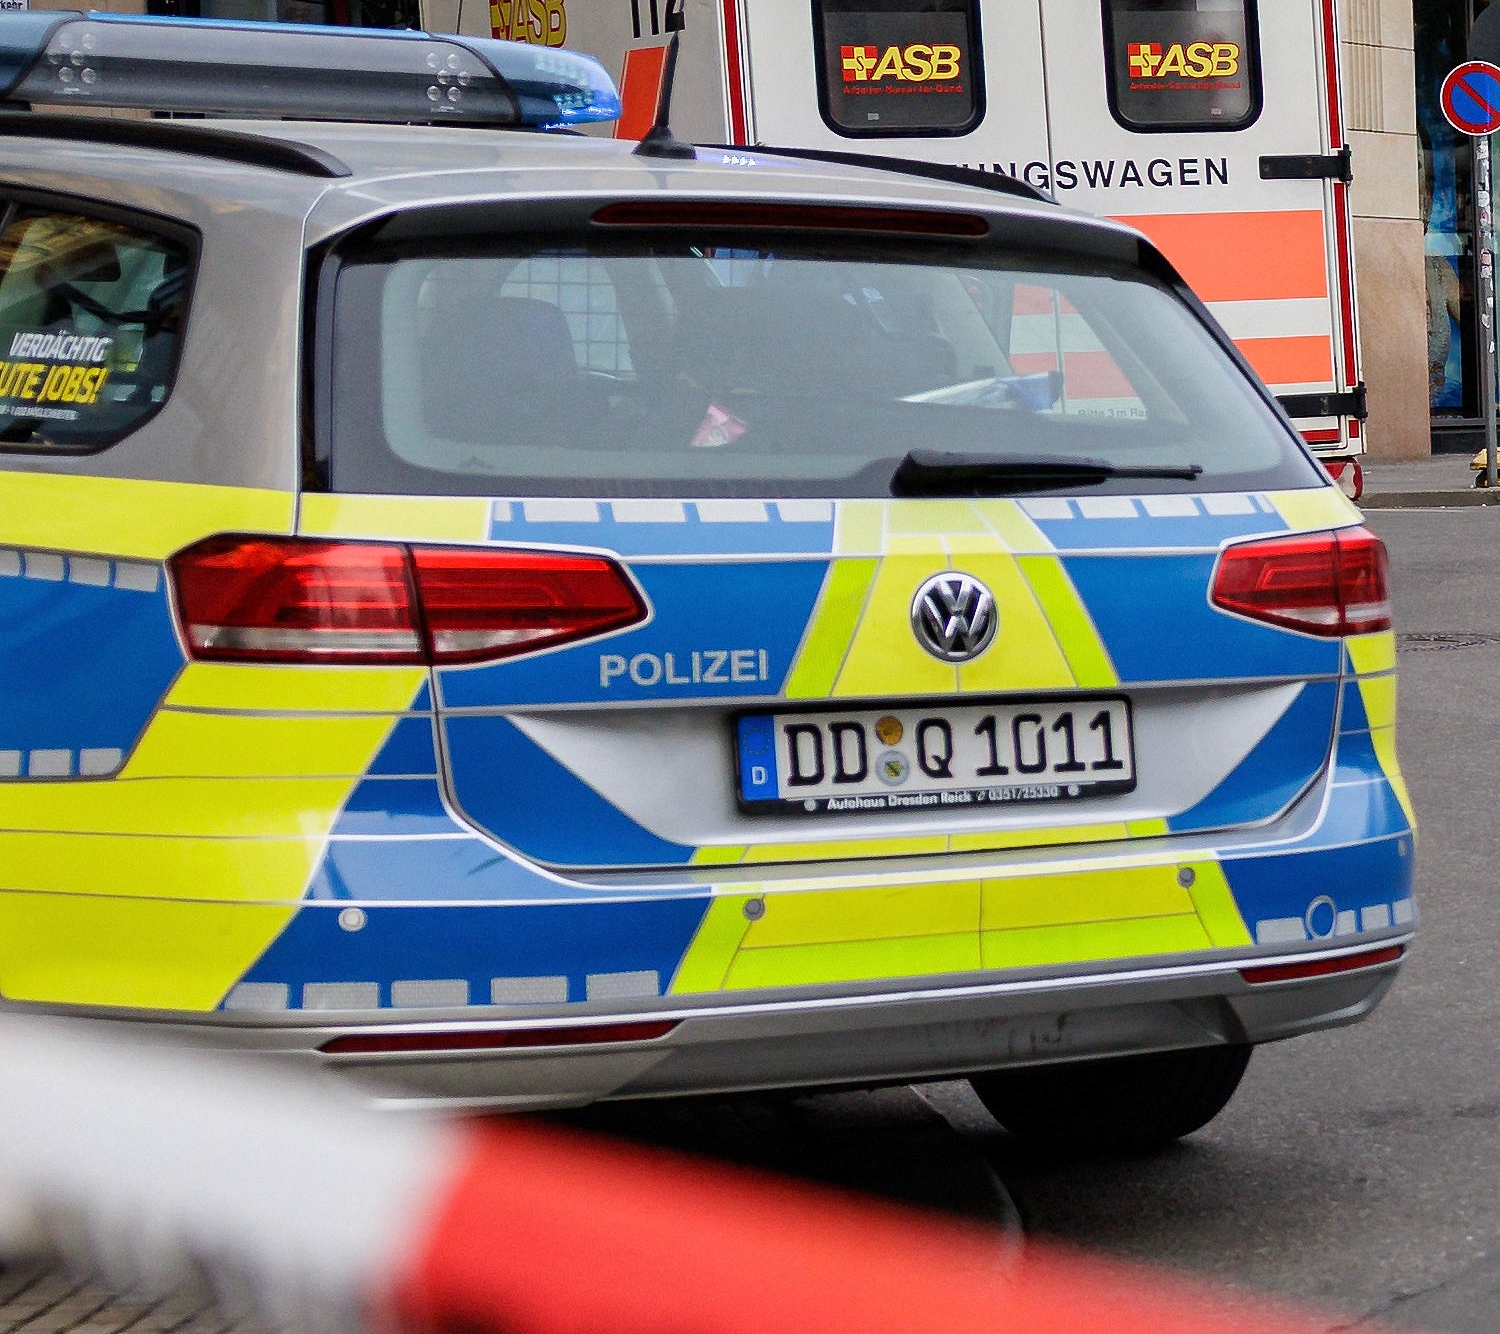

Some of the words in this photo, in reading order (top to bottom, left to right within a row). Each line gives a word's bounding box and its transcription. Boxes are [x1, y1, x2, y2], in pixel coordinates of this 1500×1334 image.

[871, 42, 962, 82] ASB
[1156, 41, 1240, 79] ASB
[954, 157, 1229, 190] NGSWAGEN
[36, 365, 109, 404] JOBS!
[1107, 409, 1114, 418] 3
[1117, 410, 1127, 418] m
[600, 649, 769, 687] POLIZEI
[752, 766, 768, 785] D
[784, 720, 868, 786] DD
[915, 717, 954, 778] Q
[974, 710, 1124, 776] 1011
[827, 796, 885, 810] Autohaus
[888, 793, 938, 806] Dresden
